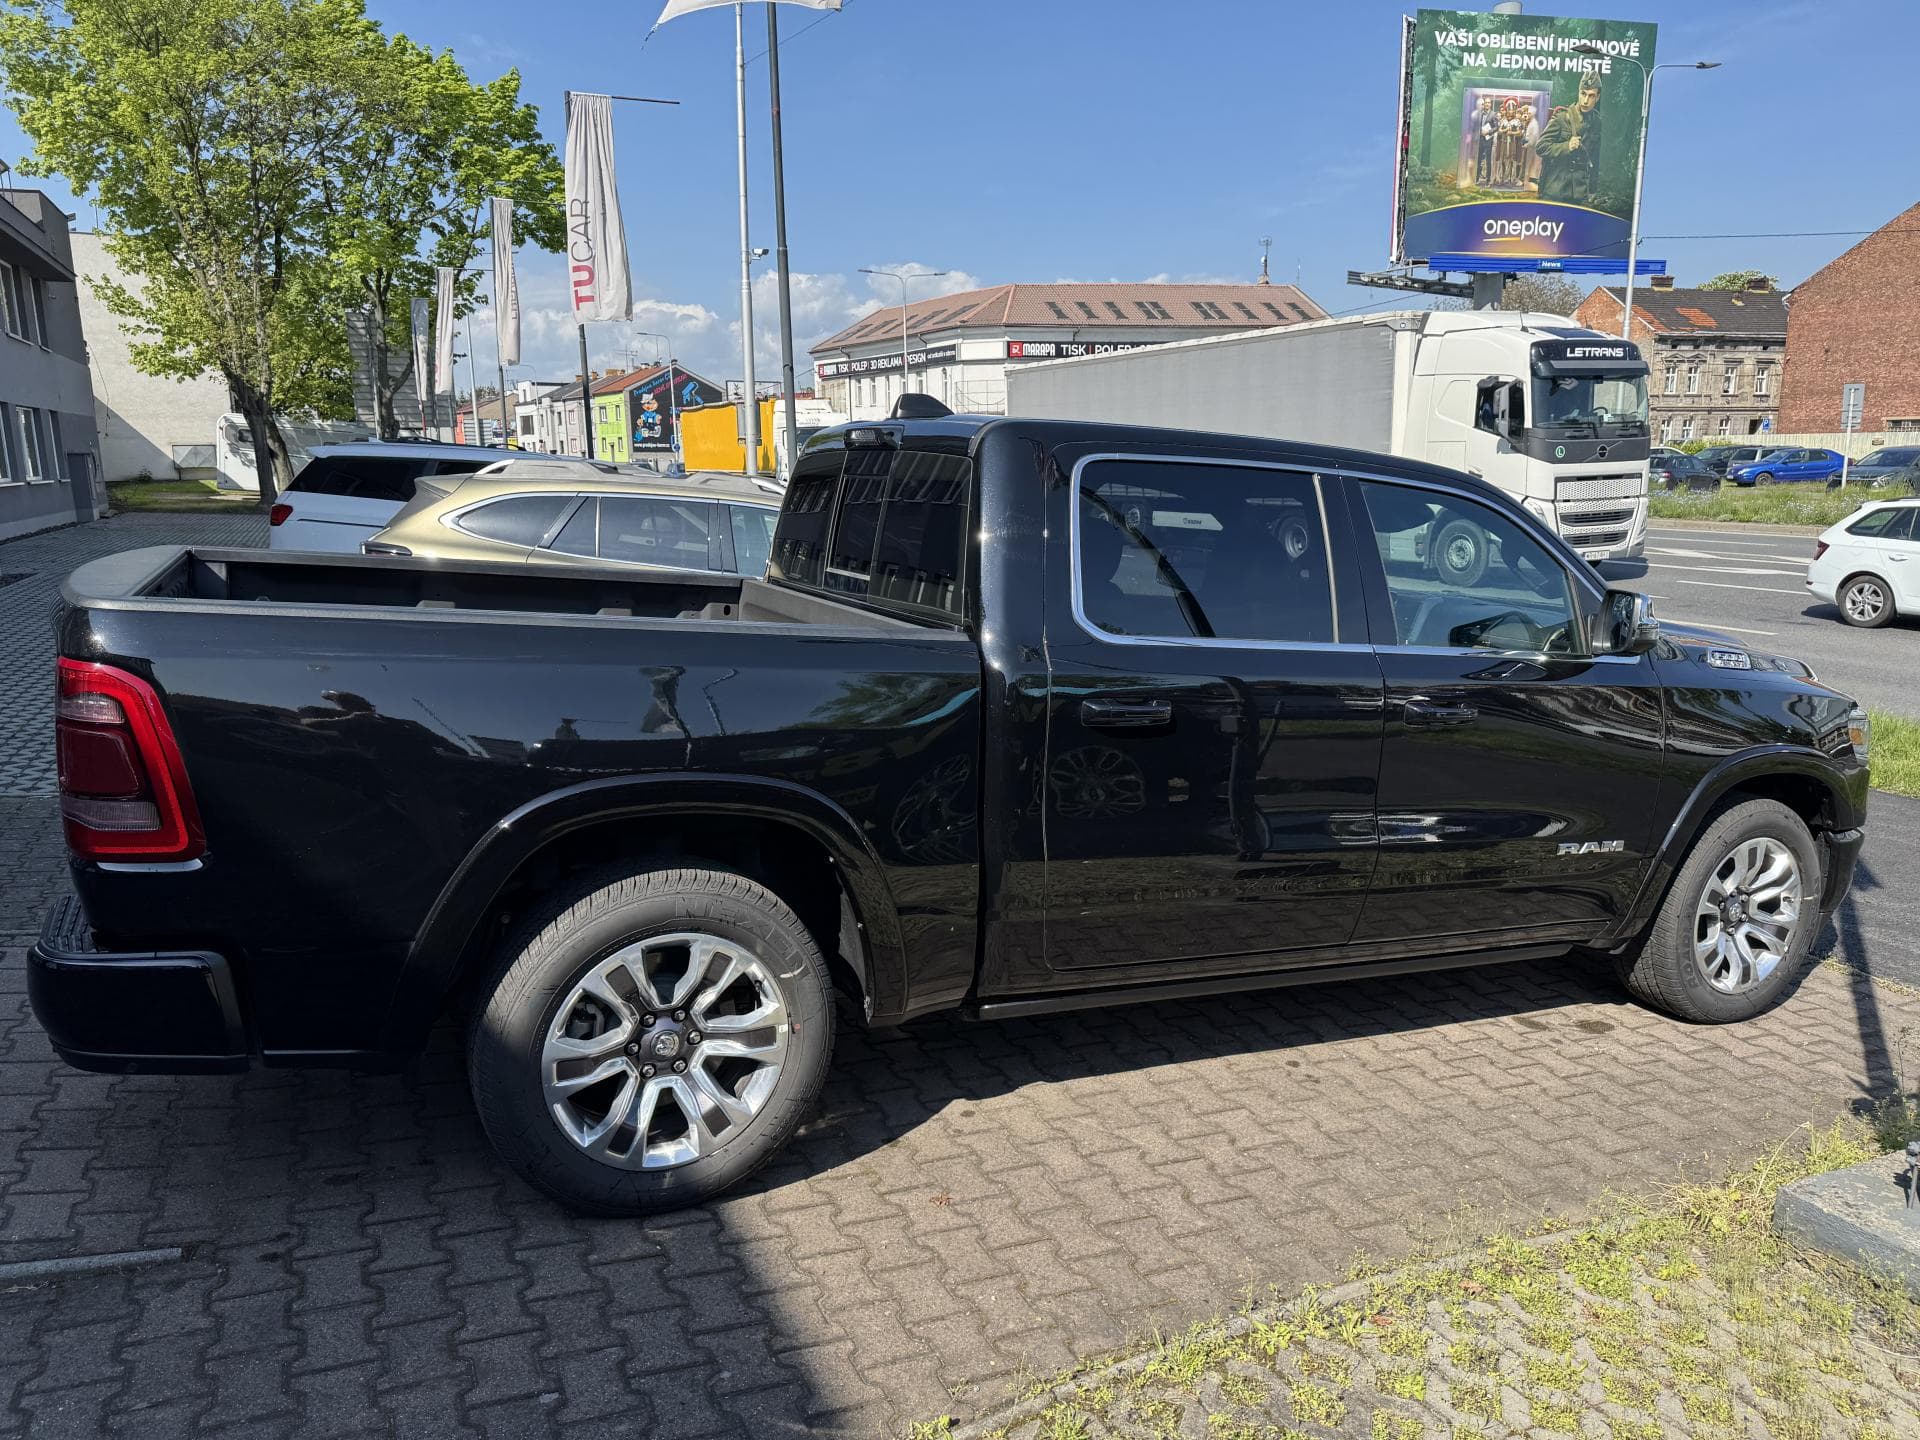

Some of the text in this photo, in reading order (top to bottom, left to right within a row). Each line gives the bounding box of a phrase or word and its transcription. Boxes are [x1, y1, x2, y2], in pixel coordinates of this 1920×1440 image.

[1435, 28, 1472, 47] VAŠI
[1477, 31, 1555, 52] OBLÍBENÍ
[1462, 52, 1612, 74] NA JEDNOM MÍSTĚ
[1483, 216, 1564, 242] oneplay
[570, 198, 595, 311] TUCAR
[1023, 343, 1055, 356] MARAPA
[1060, 344, 1086, 356] TISK
[1566, 347, 1624, 358] LETRANS
[1556, 840, 1624, 855] RAM
